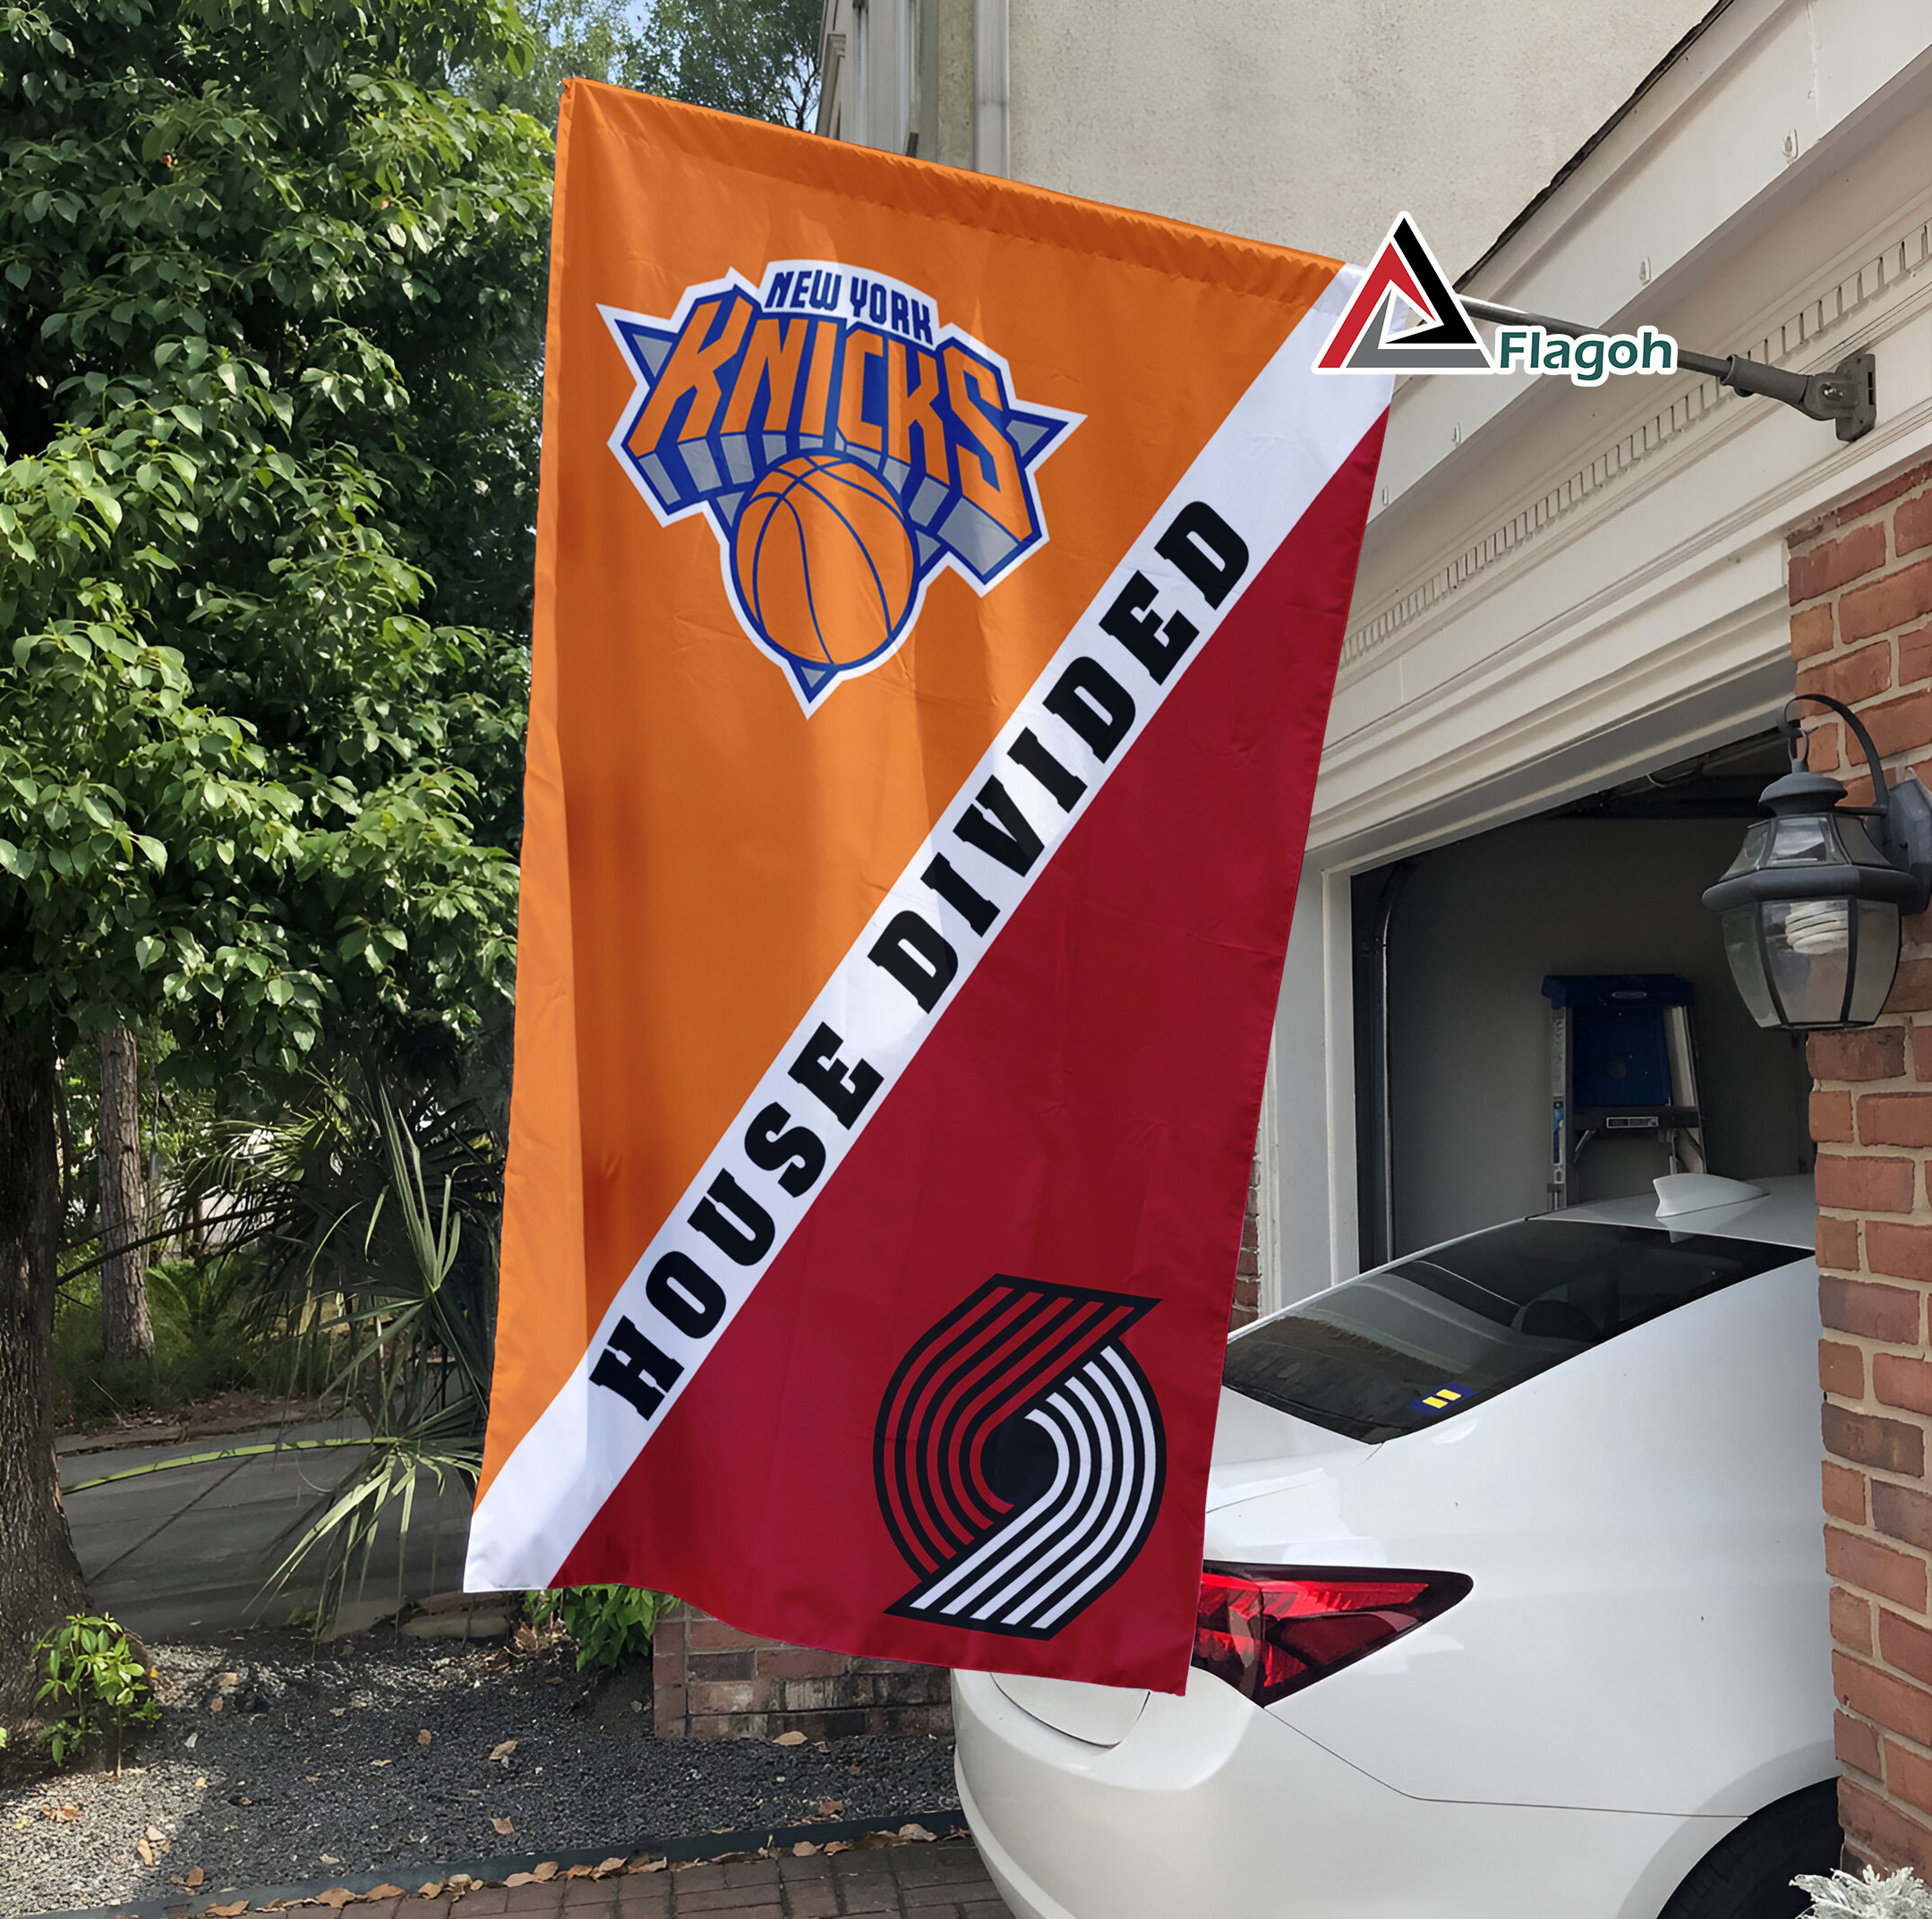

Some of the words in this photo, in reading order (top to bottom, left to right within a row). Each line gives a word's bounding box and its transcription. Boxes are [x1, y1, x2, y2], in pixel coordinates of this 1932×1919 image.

[626, 294, 1035, 544] KNICKS
[764, 269, 842, 311] NEW
[849, 276, 934, 346] YORK
[588, 1021, 885, 1421] HOUSE
[867, 501, 1250, 1014] DIVIDED
